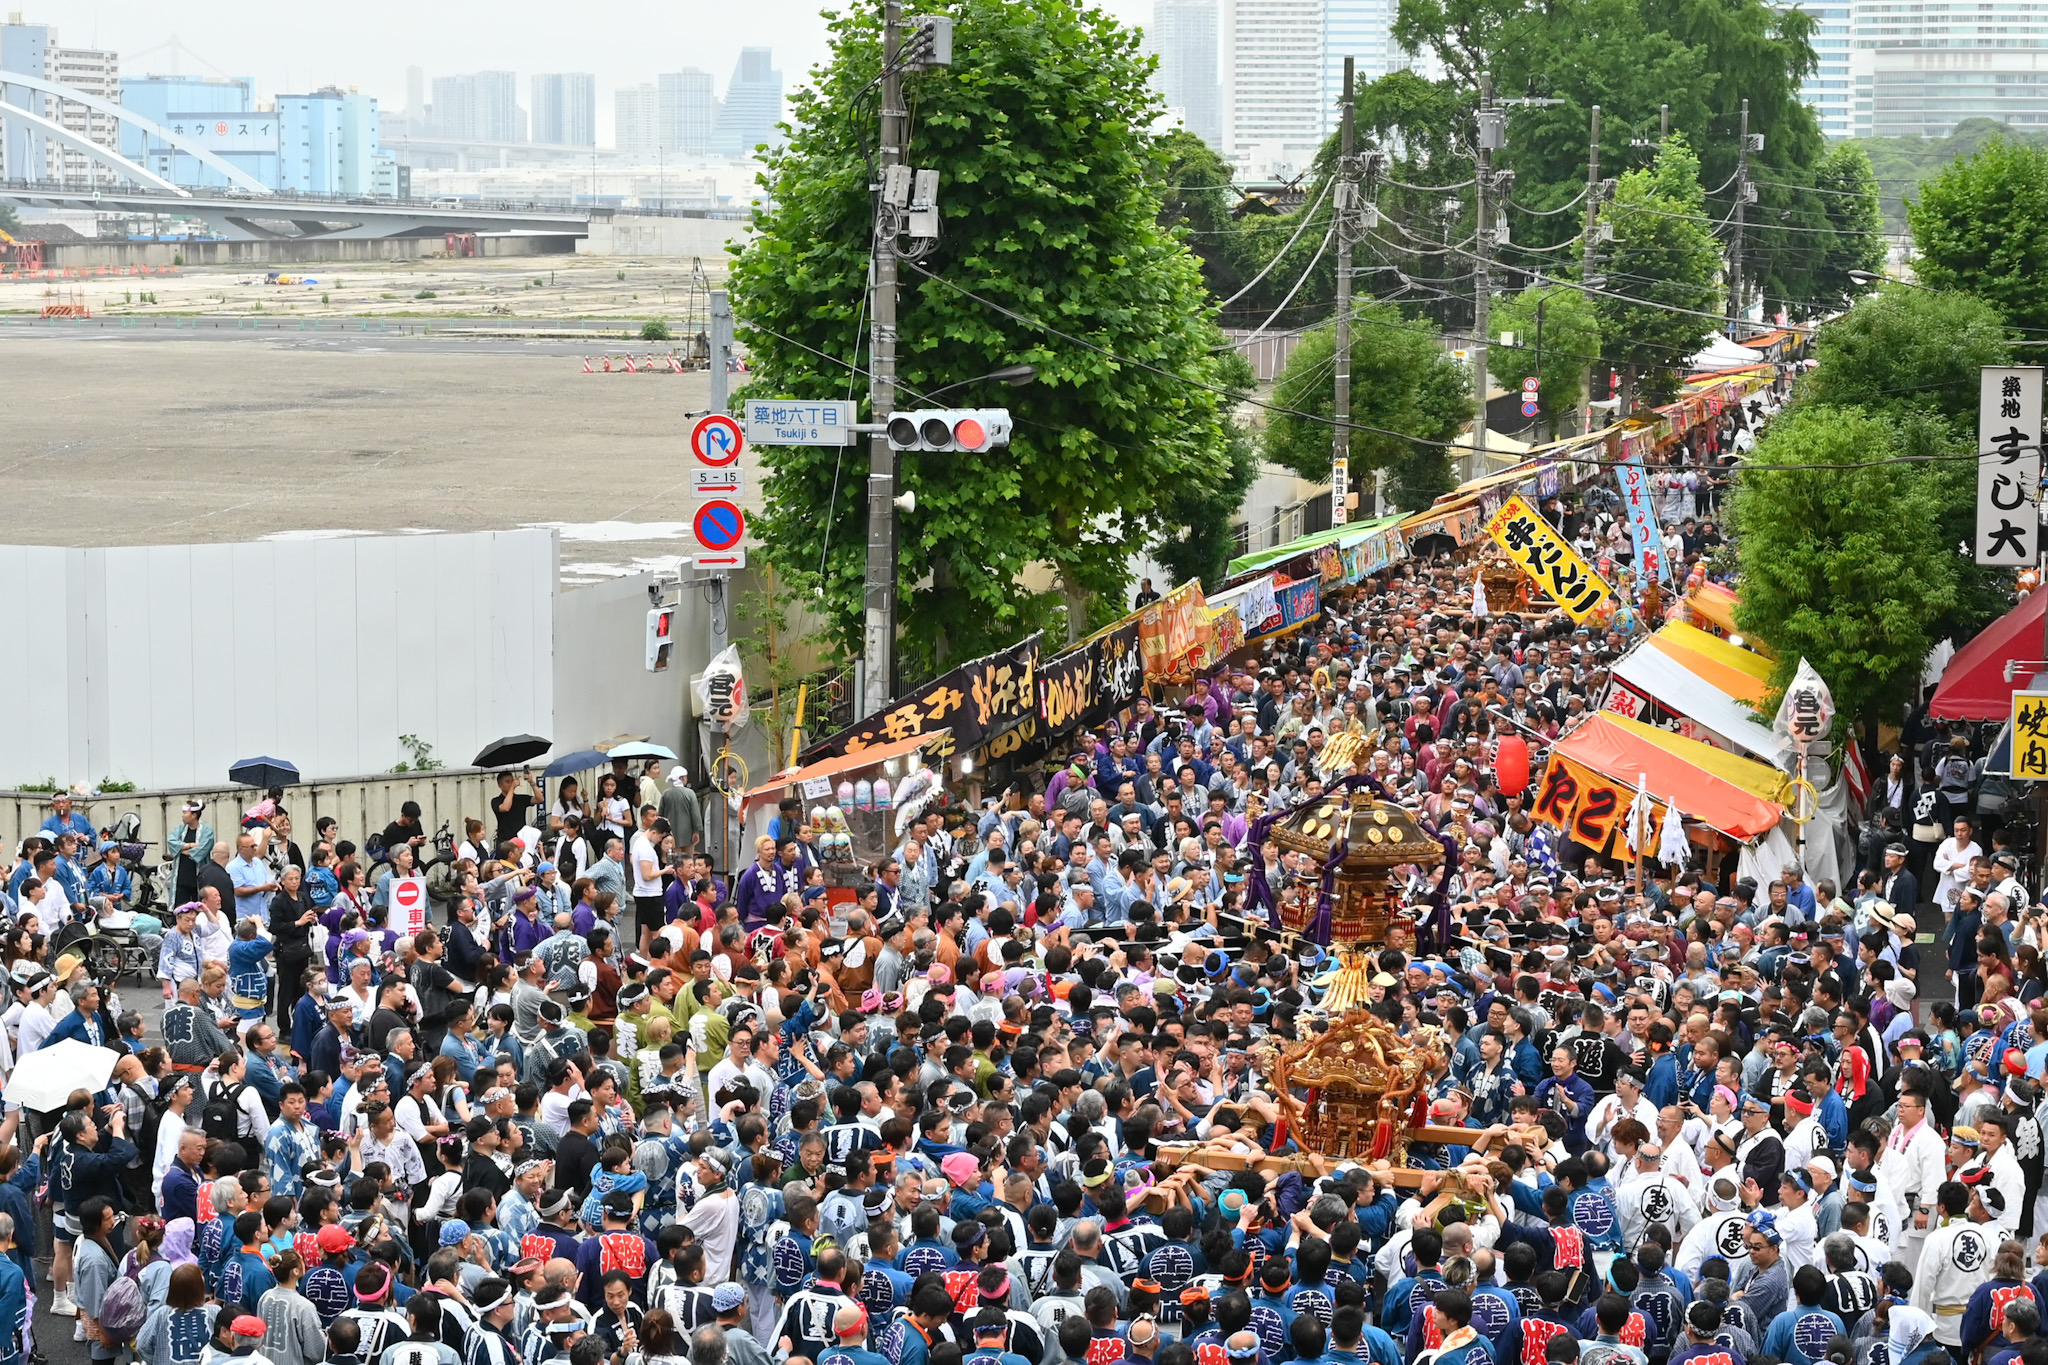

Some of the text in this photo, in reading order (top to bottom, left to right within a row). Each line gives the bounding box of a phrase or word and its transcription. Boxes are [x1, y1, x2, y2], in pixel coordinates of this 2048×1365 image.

[755, 406, 837, 426] 築地六丁目
[2001, 376, 2021, 418] 築地
[775, 428, 818, 440] Tsukiji 6
[1335, 467, 1344, 495] 時間貸
[1335, 496, 1344, 506] P
[1986, 426, 2030, 558] すし大
[1489, 502, 1521, 535] 炭火焼
[1505, 516, 1602, 613] 串だんご
[709, 669, 736, 716] 宮元
[1793, 685, 1820, 737] 宮元
[2017, 700, 2048, 775] 焼肉
